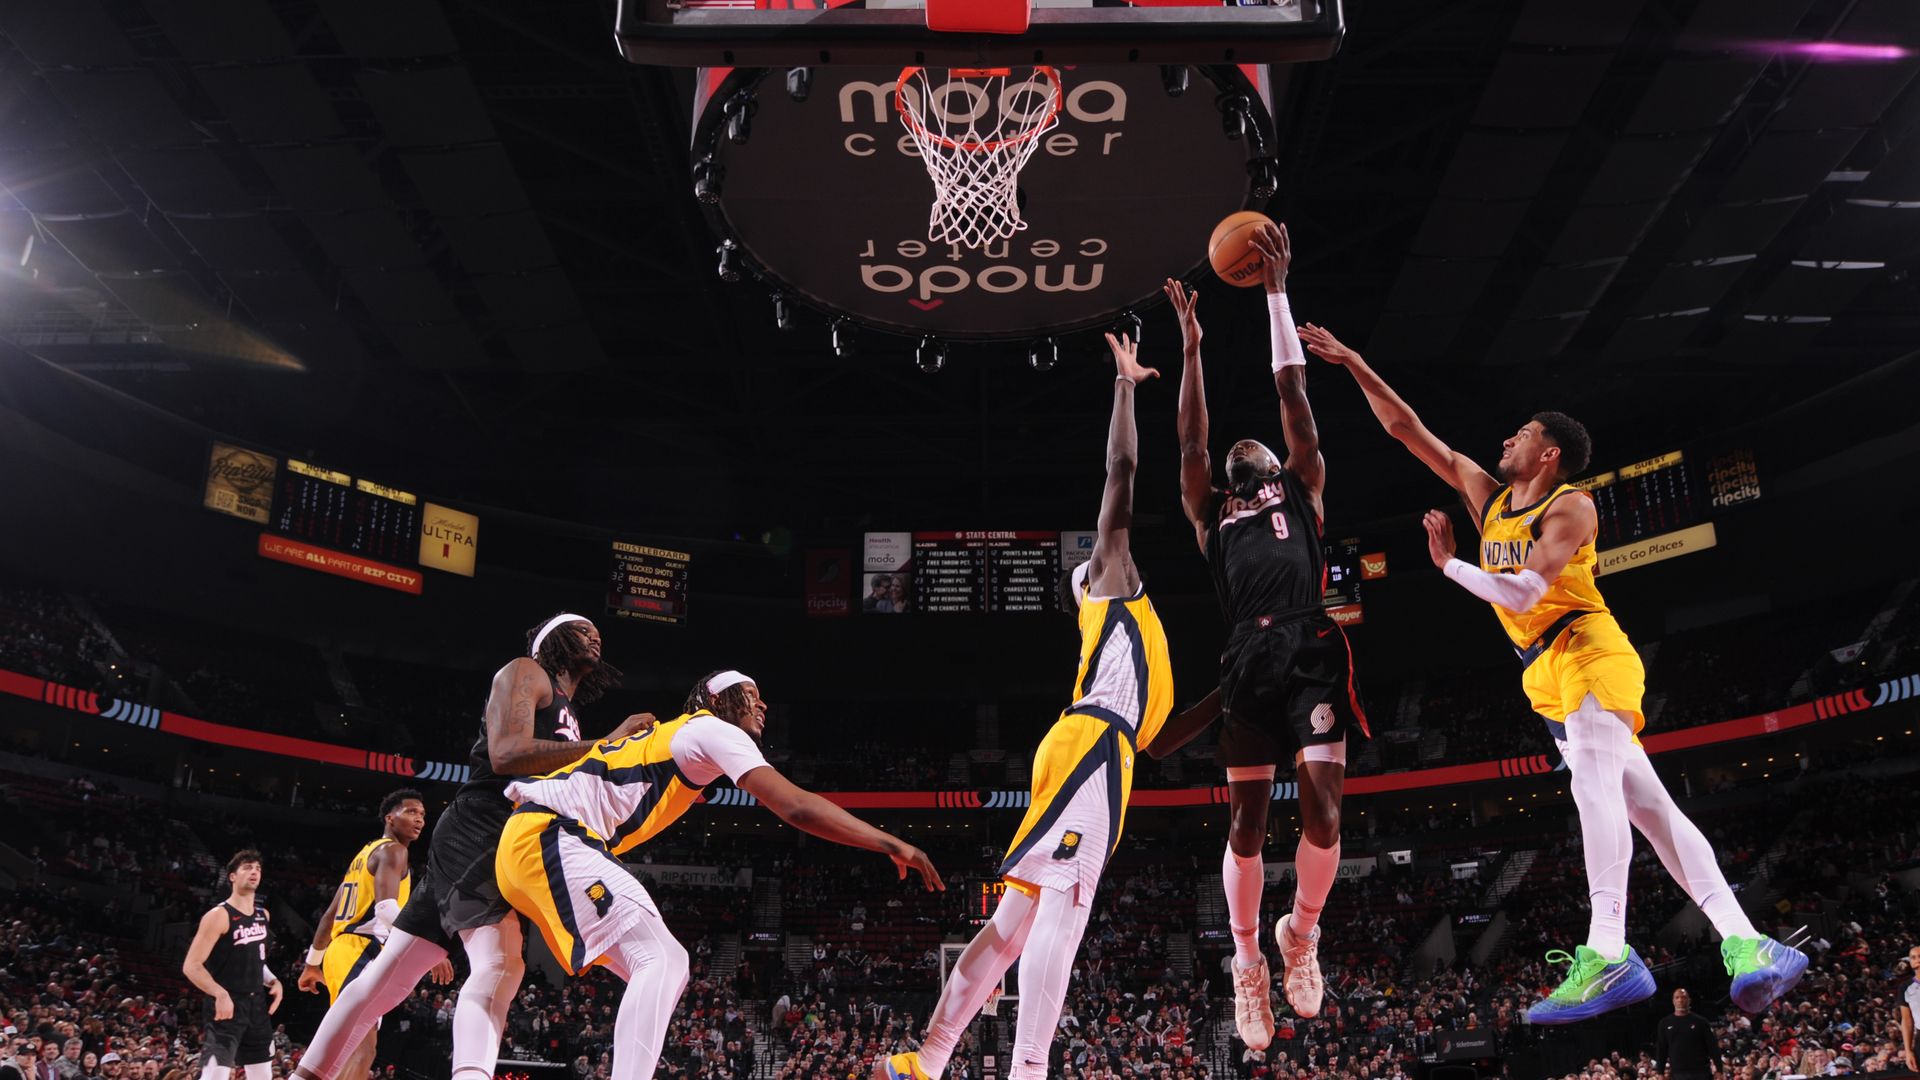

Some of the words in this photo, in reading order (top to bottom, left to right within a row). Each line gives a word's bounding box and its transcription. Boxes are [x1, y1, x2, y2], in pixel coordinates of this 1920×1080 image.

[839, 68, 1127, 123] moda
[860, 262, 1105, 300] moda
[1634, 456, 1666, 470] GUEST
[1710, 473, 1759, 495] ripcity
[1712, 485, 1761, 507] ripcity
[237, 503, 257, 518] NOW
[1271, 511, 1289, 540] 9
[423, 524, 474, 548] ULTRA
[966, 531, 986, 539] STATS
[988, 531, 1017, 539] CENTRAL
[617, 543, 685, 560] HUSTLEBOARD
[868, 554, 896, 563] moda
[1604, 552, 1628, 568] Let's
[1629, 550, 1647, 561] Go
[1648, 539, 1685, 556] Places
[264, 541, 283, 554] WE
[283, 547, 305, 560] ARE
[305, 552, 326, 564] ALL
[326, 558, 351, 571] PART
[351, 564, 362, 574] OF
[363, 566, 386, 579] RIP
[387, 571, 417, 586] CITY
[628, 574, 670, 588] REBOUNDS
[654, 567, 674, 578] SHOTS
[630, 586, 666, 599] STEALS
[807, 596, 848, 610] ripcity
[661, 871, 679, 882] RIP
[682, 871, 708, 883] CITY
[233, 922, 267, 944] ripcity
